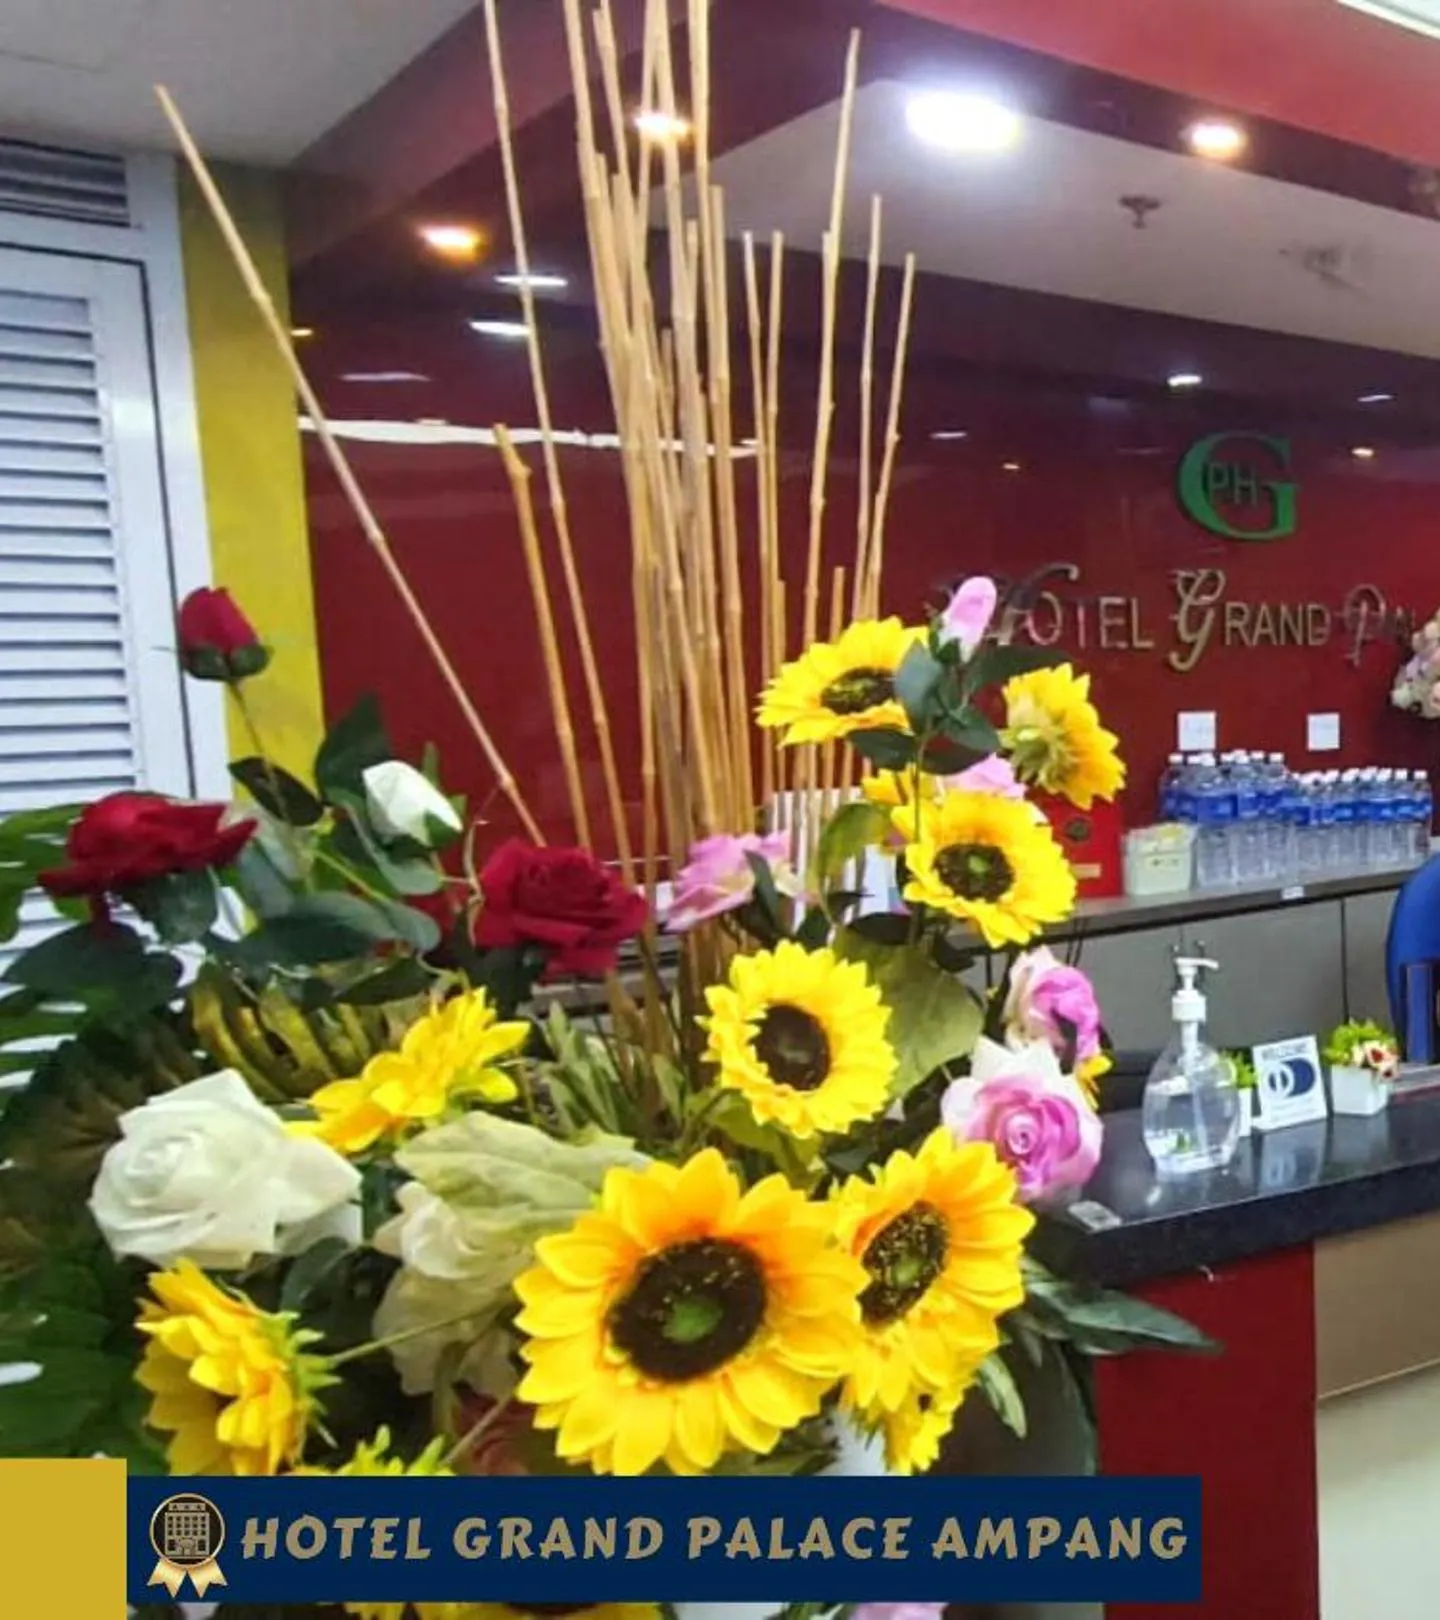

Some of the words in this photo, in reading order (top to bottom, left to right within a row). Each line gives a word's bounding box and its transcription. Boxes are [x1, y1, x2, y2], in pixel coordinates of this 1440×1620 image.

[1178, 430, 1301, 541] G
[1209, 461, 1258, 508] PH
[1169, 569, 1331, 671] GRAND
